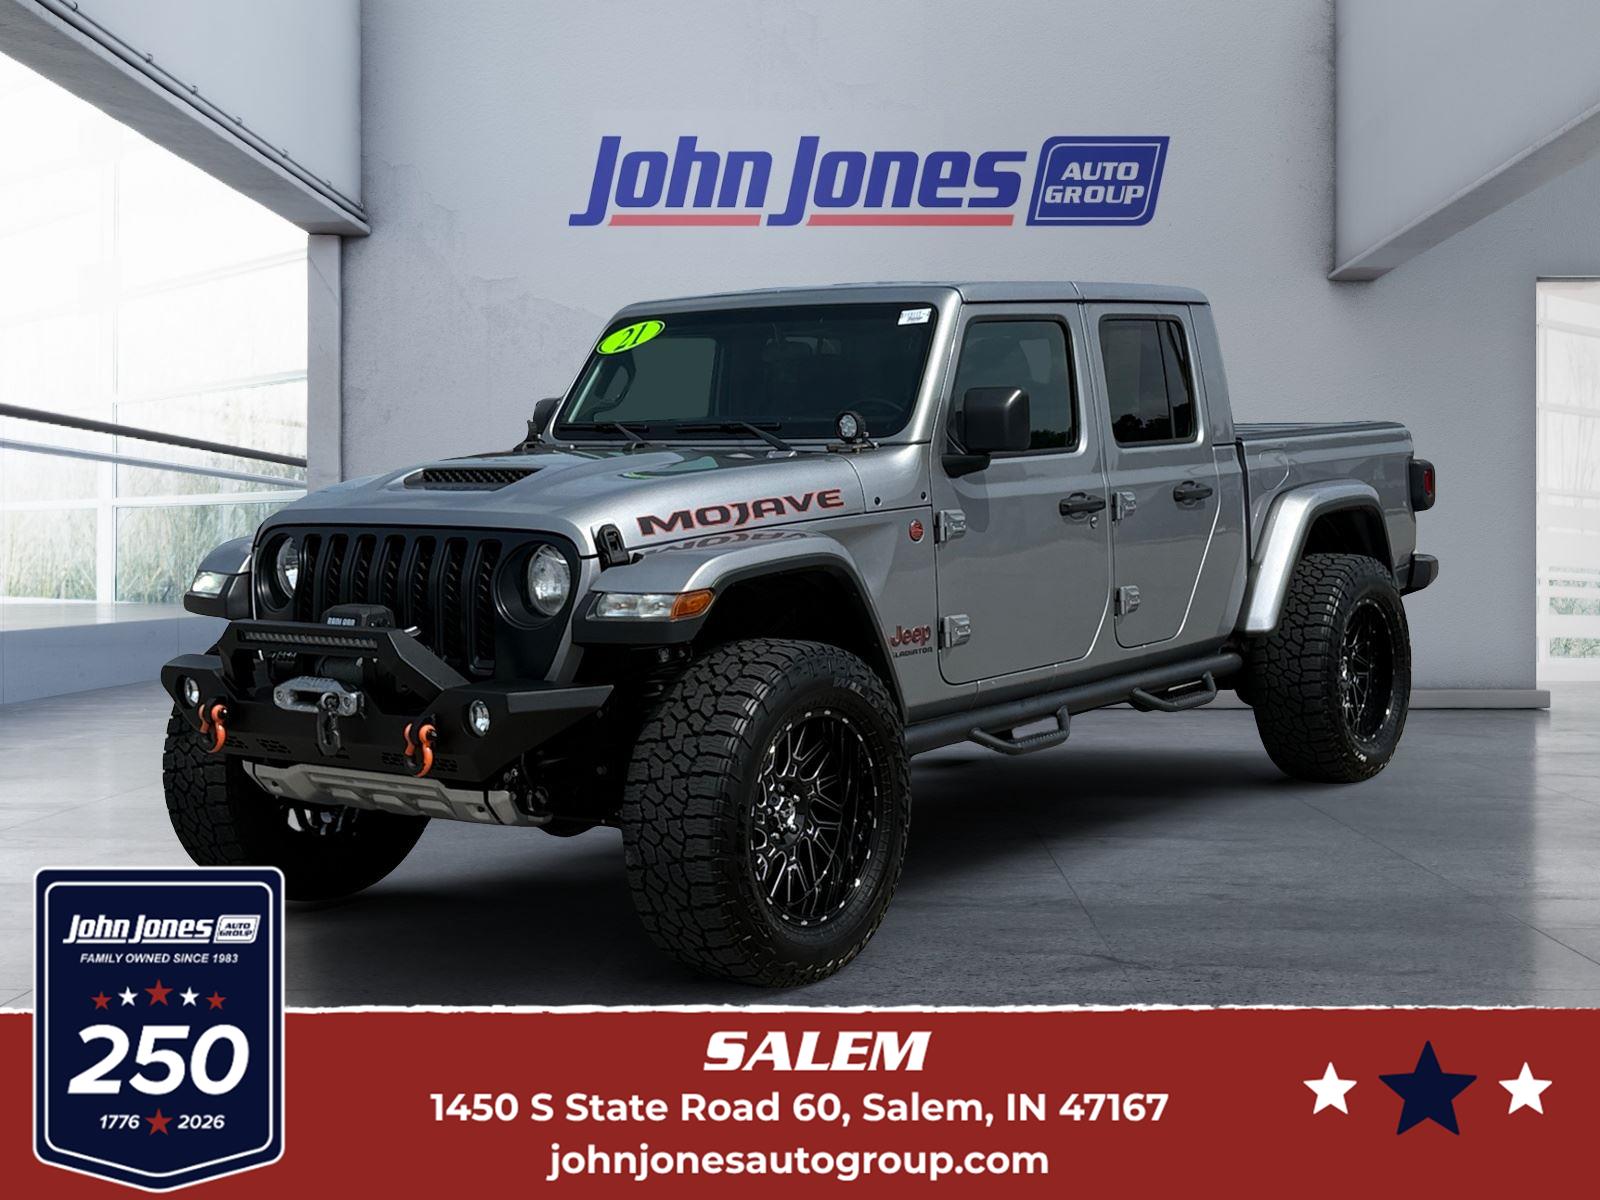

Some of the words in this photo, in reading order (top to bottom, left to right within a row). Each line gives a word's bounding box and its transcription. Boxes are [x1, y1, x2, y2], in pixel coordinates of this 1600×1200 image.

[568, 135, 773, 227] John
[767, 135, 1028, 227] Jones
[1060, 161, 1140, 182] AUTO
[1044, 185, 1145, 205] GROUP
[613, 322, 649, 352] 21
[636, 488, 845, 536] MOJAVE
[889, 624, 932, 647] Jeep
